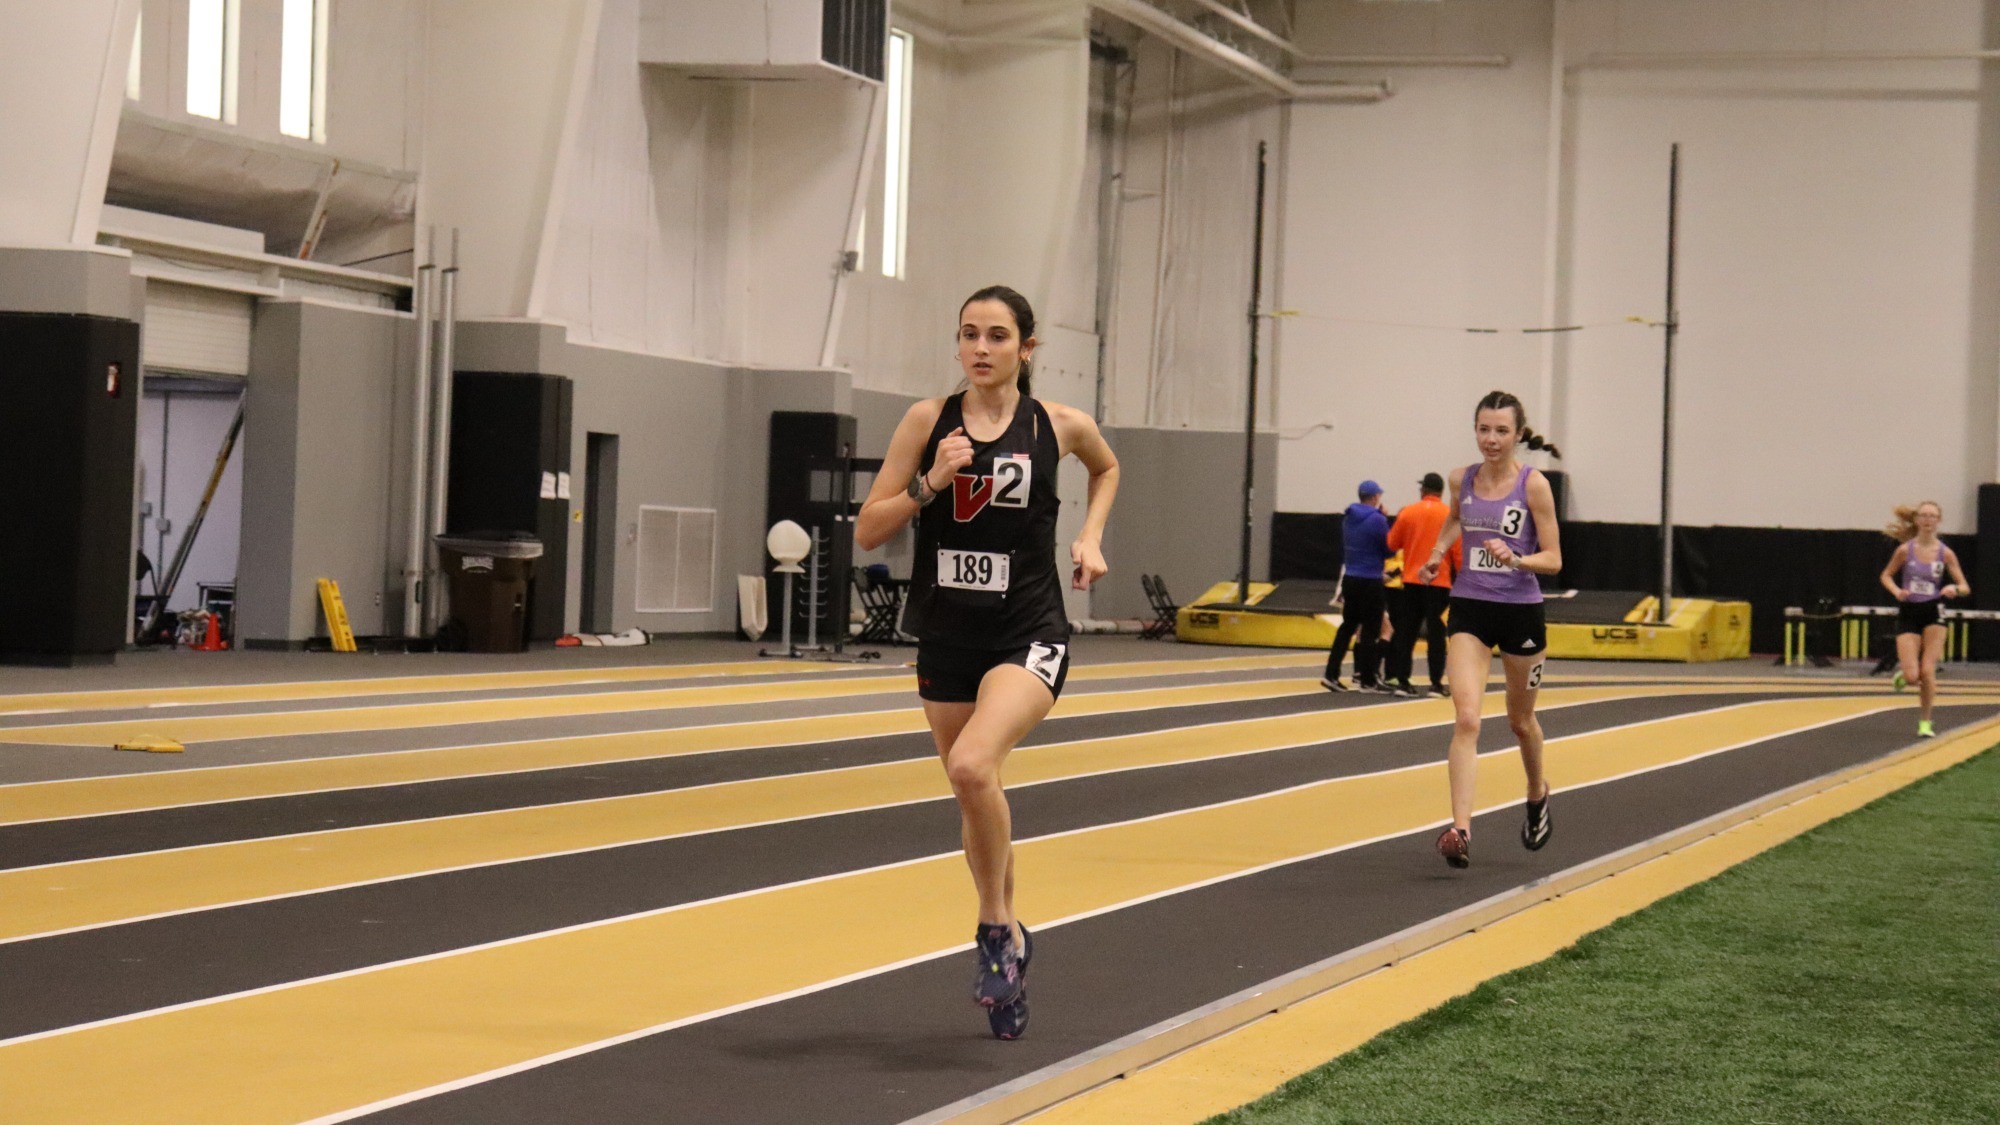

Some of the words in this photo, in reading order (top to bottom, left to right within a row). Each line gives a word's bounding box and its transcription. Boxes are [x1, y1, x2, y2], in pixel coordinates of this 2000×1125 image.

[953, 474, 993, 523] V
[995, 462, 1023, 504] 2
[1503, 509, 1522, 535] 3
[953, 554, 993, 585] 189
[1592, 628, 1638, 639] UCS
[1035, 643, 1059, 680] 2
[1530, 664, 1542, 687] 3
